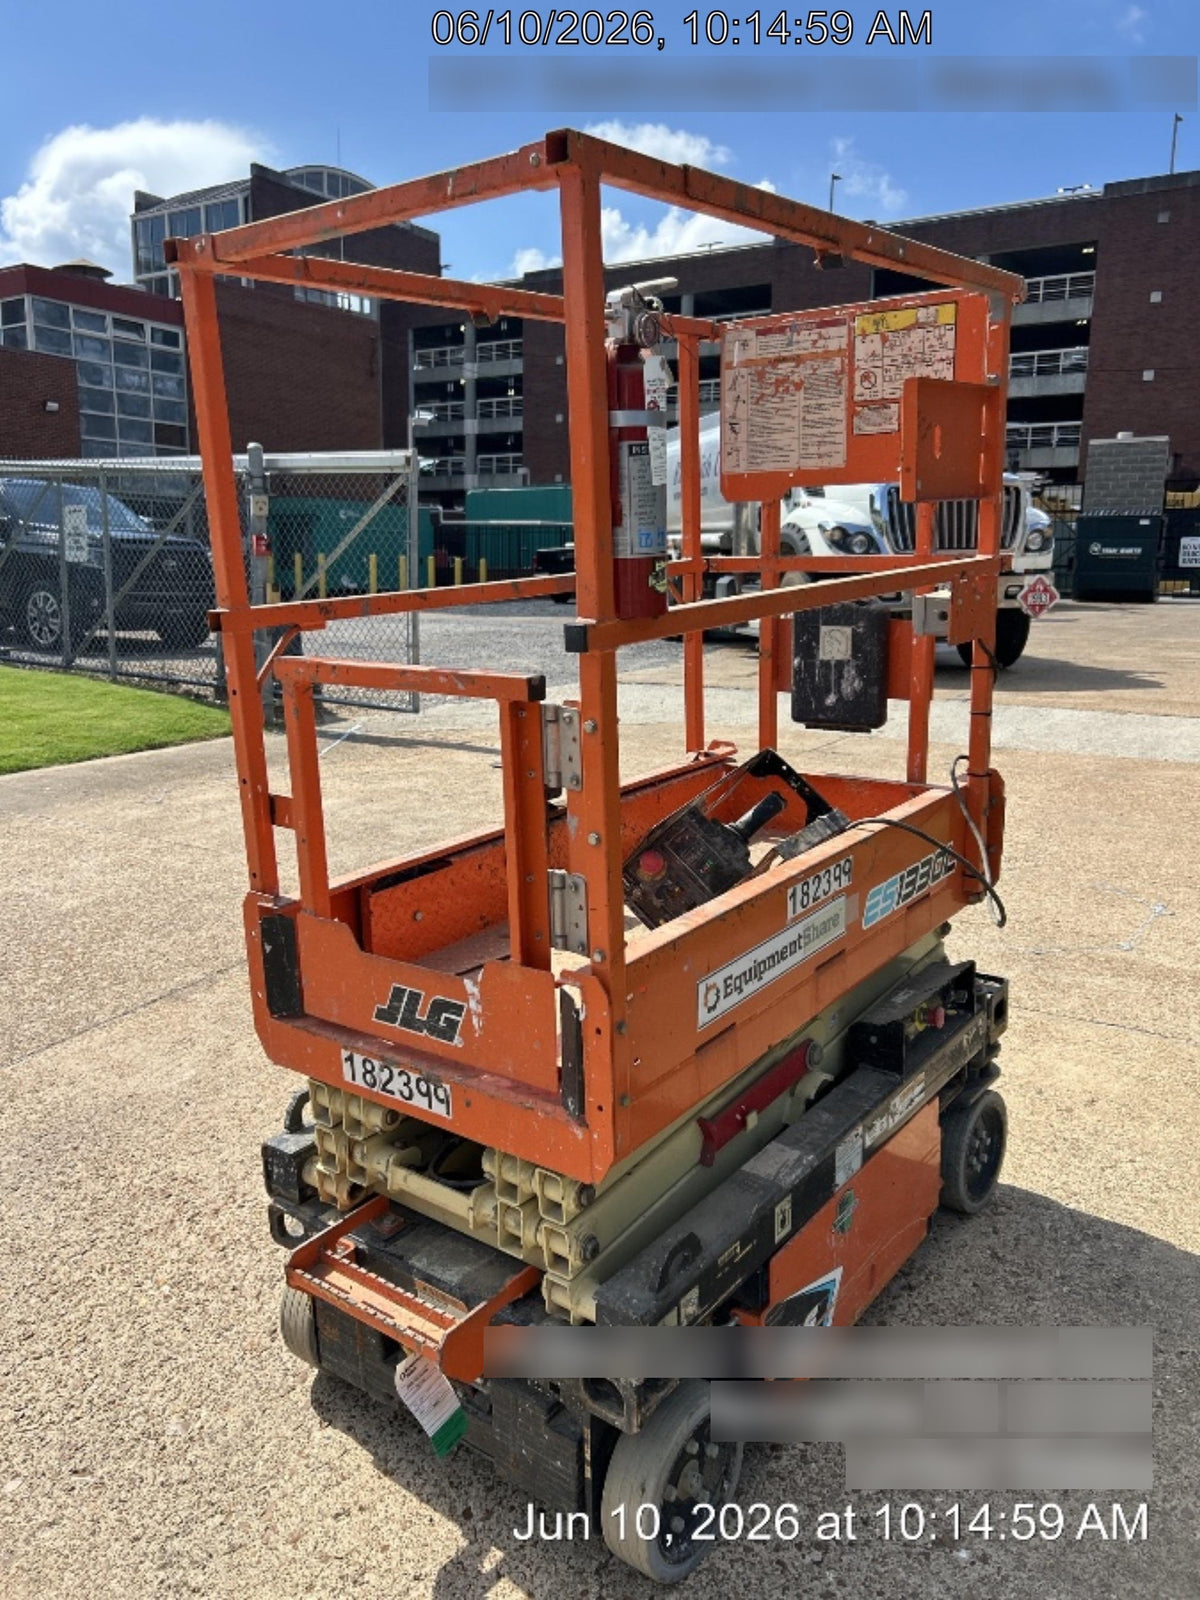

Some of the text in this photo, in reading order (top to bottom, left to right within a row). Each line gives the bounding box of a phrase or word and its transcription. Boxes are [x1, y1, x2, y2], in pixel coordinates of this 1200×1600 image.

[788, 857, 853, 917] 182399
[722, 907, 842, 1000] EquipmentShare
[372, 983, 467, 1046] JLG
[343, 1050, 452, 1118] 182399
